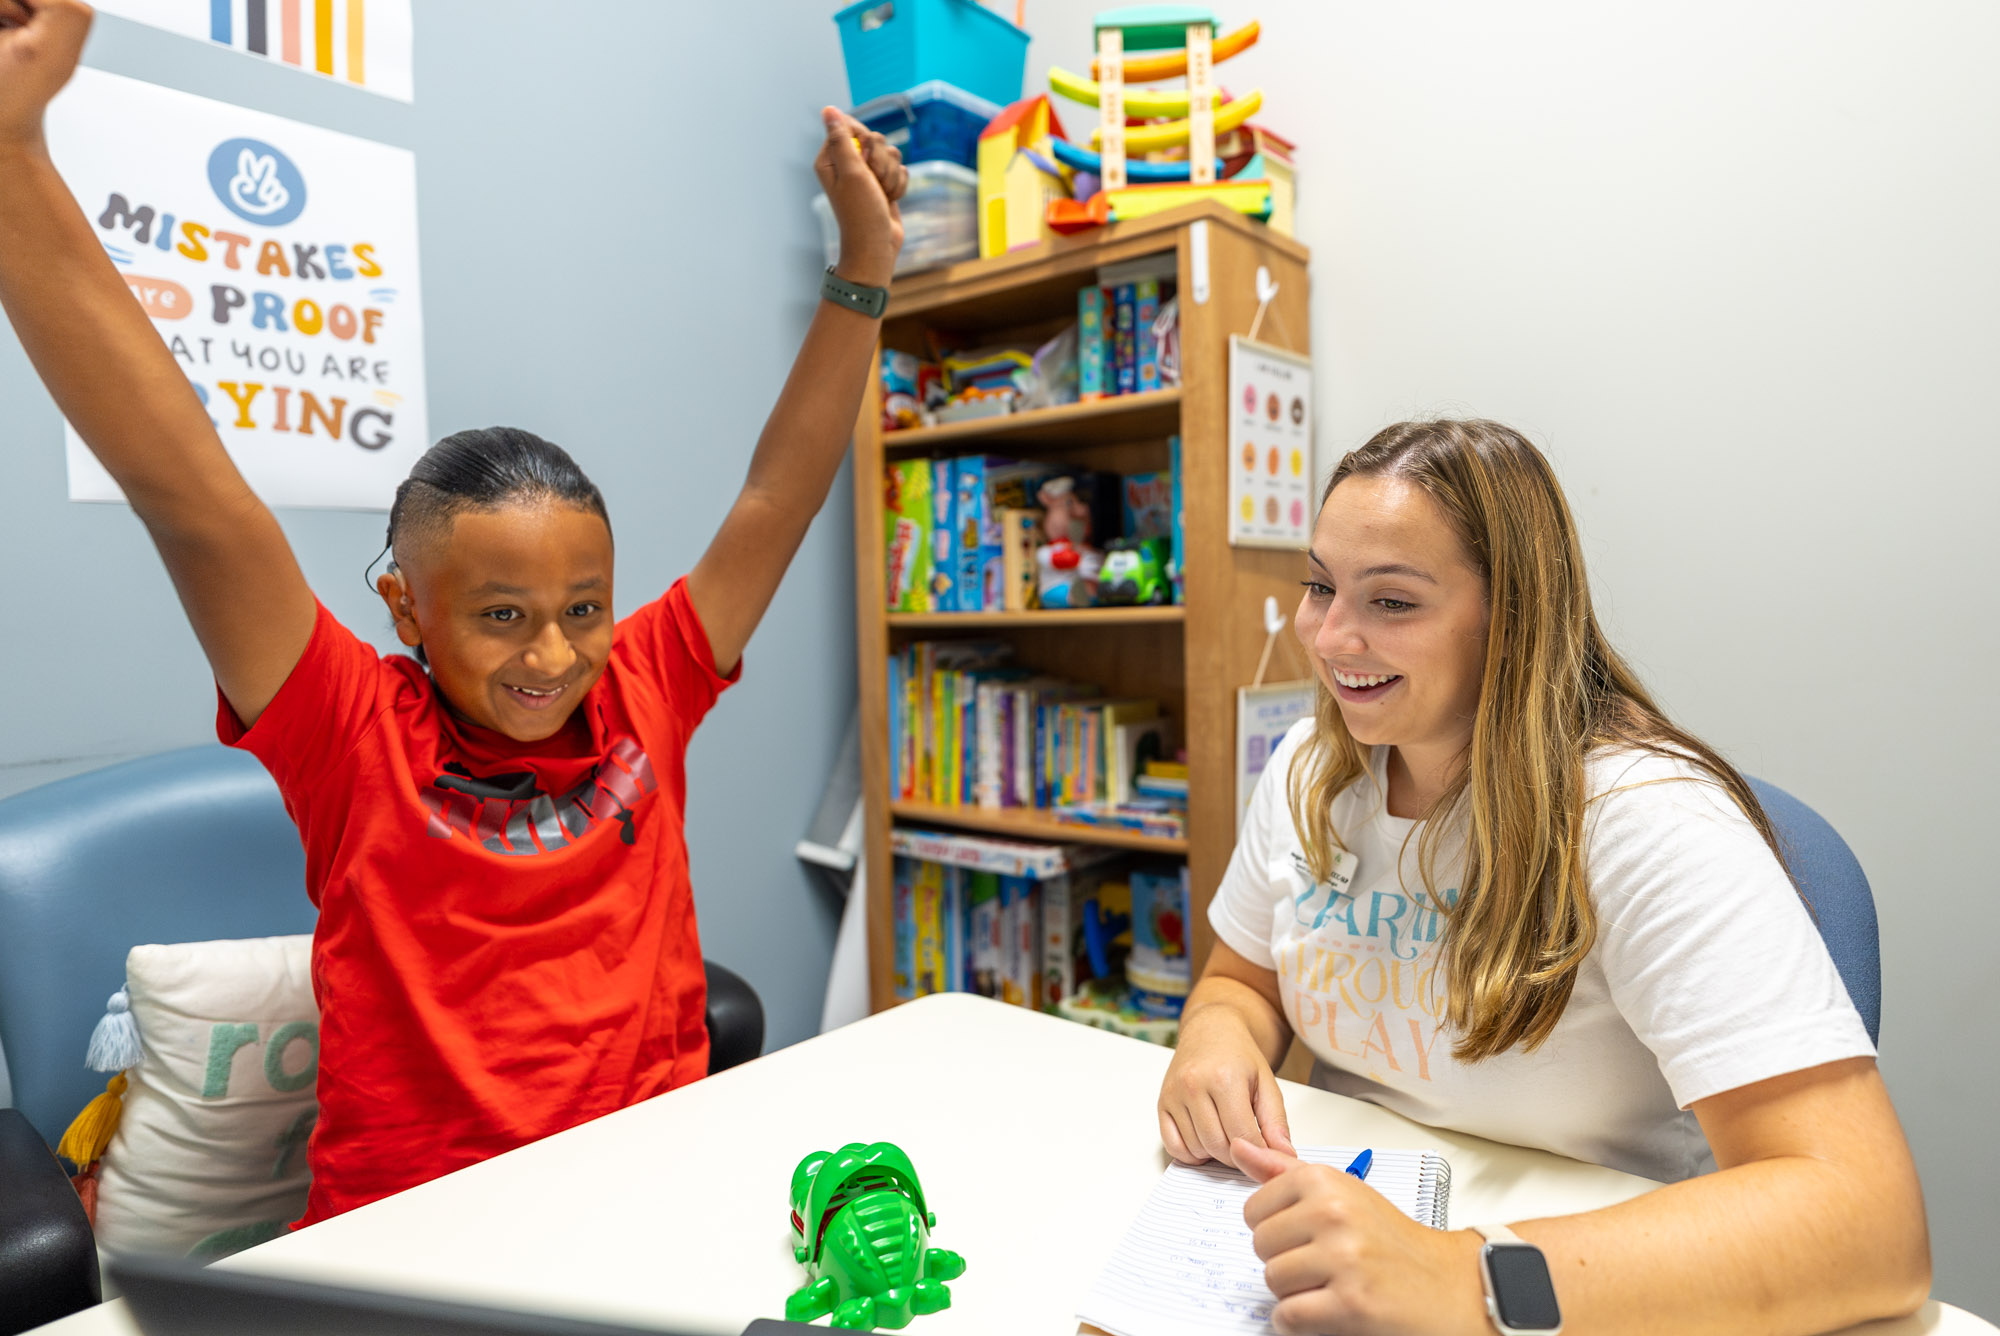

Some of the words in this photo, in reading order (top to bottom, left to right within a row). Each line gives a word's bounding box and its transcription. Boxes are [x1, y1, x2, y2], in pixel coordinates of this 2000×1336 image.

[98, 193, 383, 280] MISTAKES
[210, 284, 384, 345] PROOF
[170, 334, 214, 365] AT
[230, 338, 306, 376] YOU
[320, 353, 390, 385] ARE
[191, 379, 394, 452] YING
[1280, 937, 1446, 1020] THROUG
[1294, 990, 1441, 1083] PLAY
